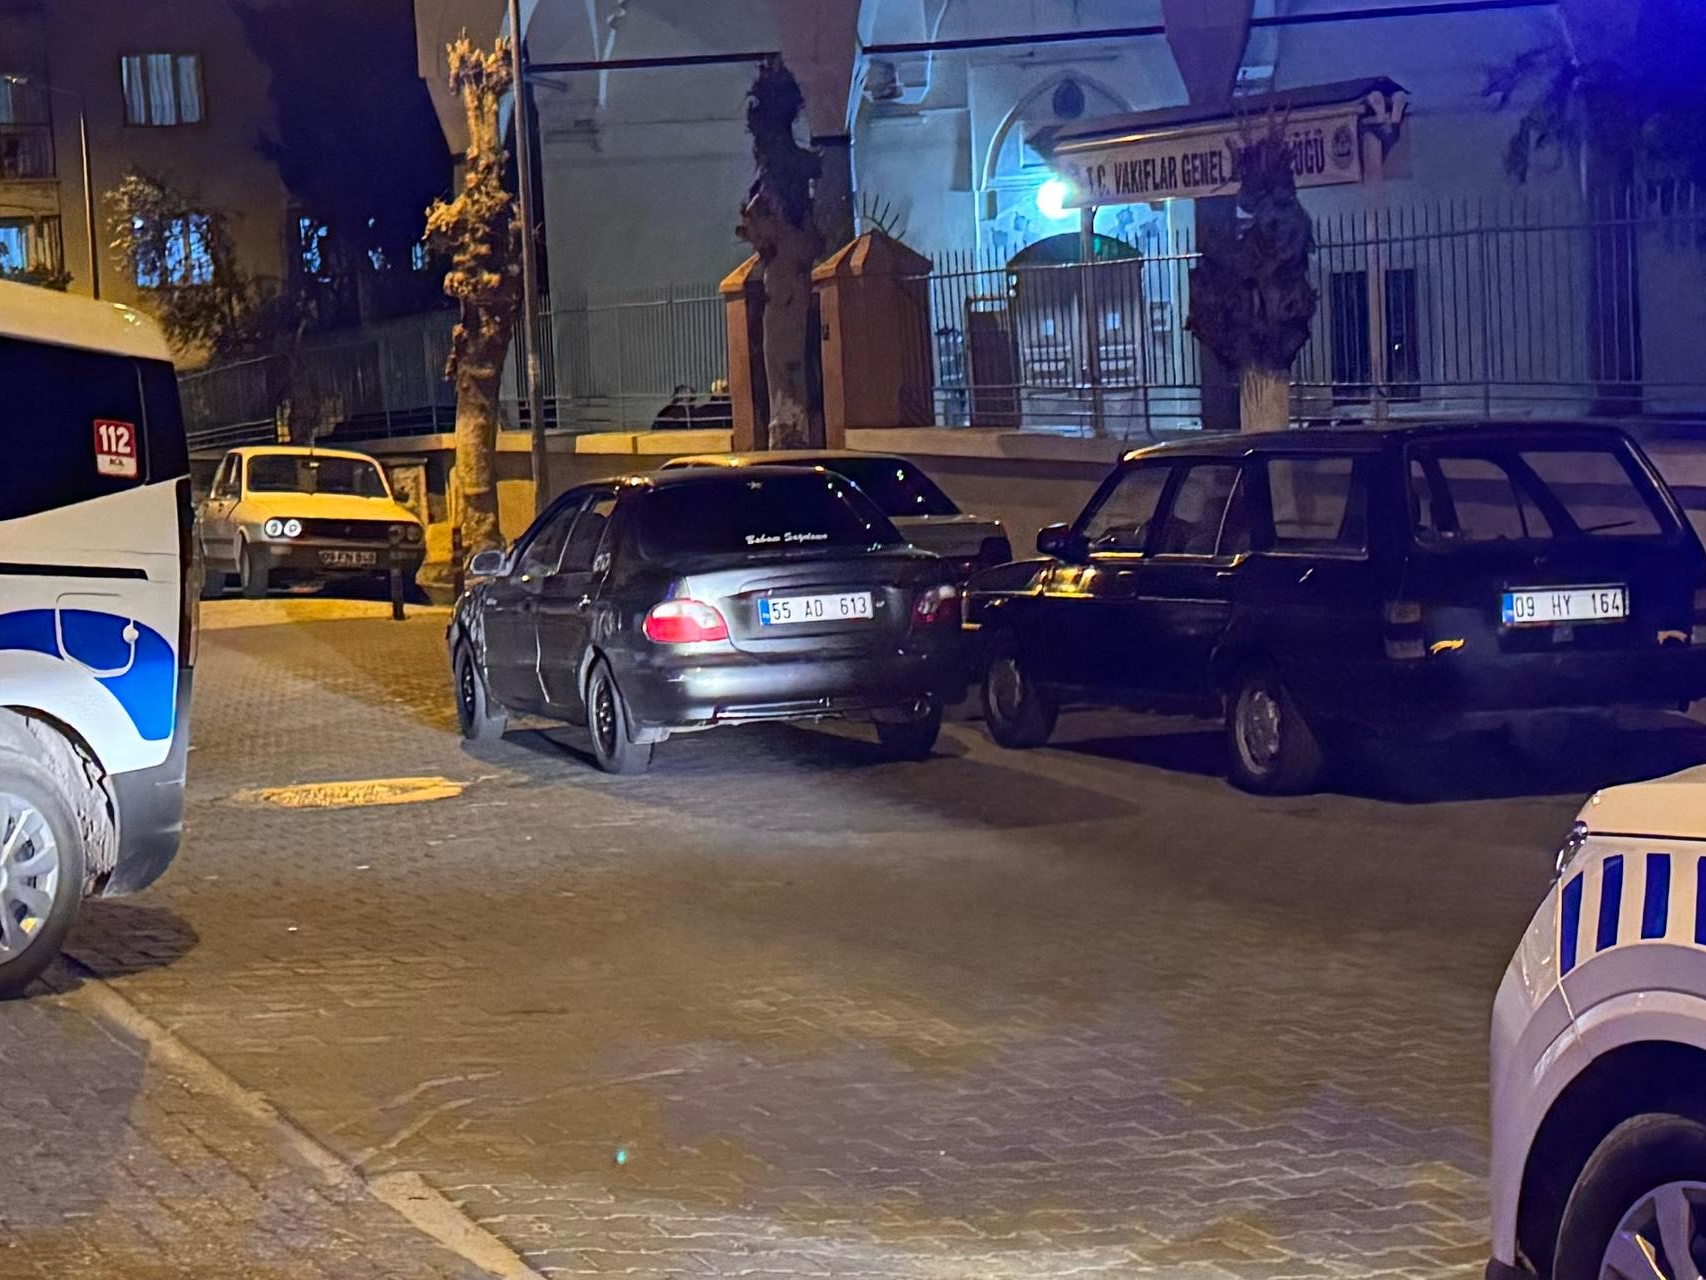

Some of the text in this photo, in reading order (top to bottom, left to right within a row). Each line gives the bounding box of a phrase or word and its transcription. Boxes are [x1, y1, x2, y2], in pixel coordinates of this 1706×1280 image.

[1114, 156, 1178, 195] VAKIFLAR
[1181, 150, 1226, 187] GENEL
[99, 424, 131, 454] 112
[772, 596, 867, 620] 55 AD 613
[1515, 592, 1620, 618] 09 HY 164
